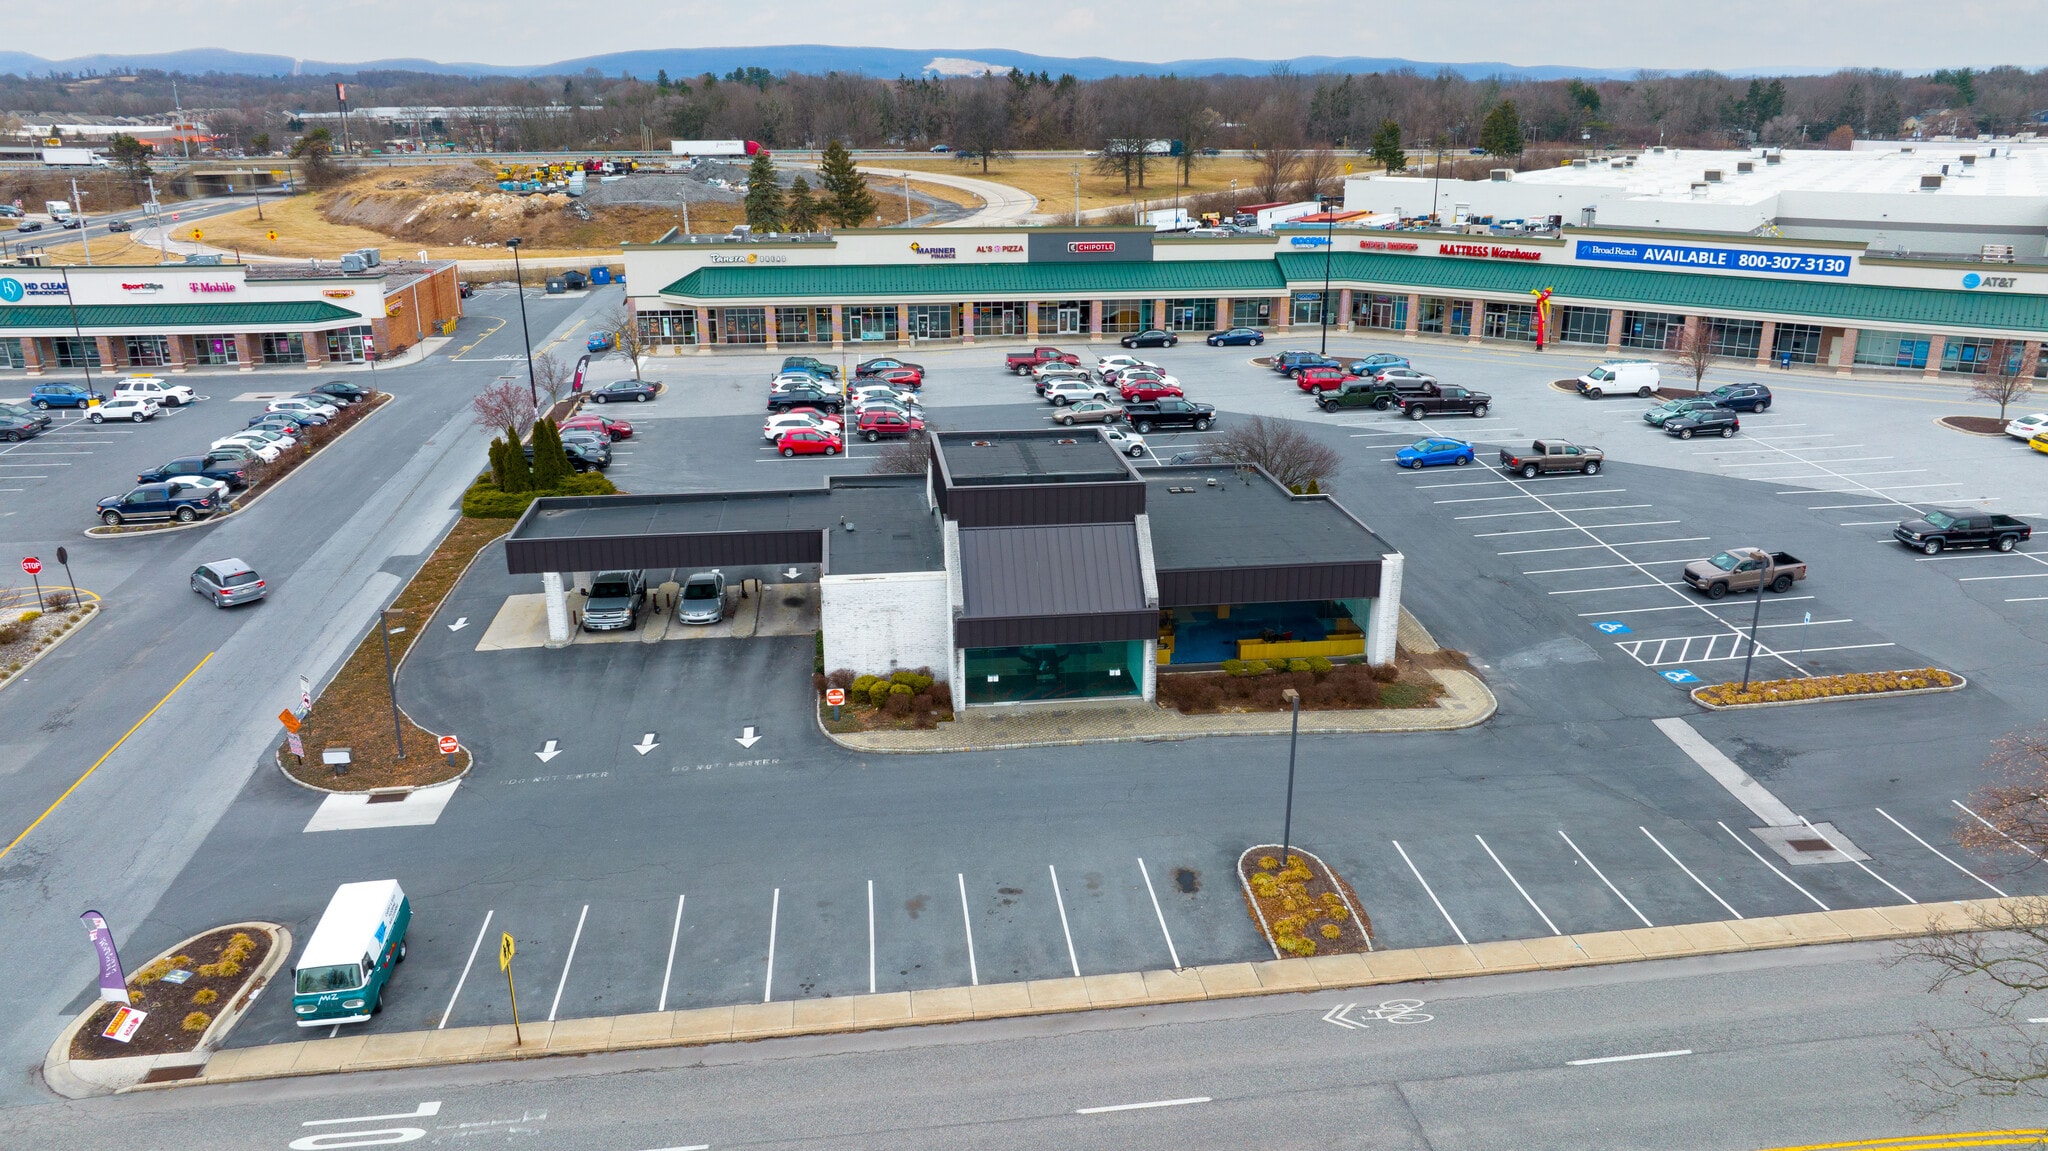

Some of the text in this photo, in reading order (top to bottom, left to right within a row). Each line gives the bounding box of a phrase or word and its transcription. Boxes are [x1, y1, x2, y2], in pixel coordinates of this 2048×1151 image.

[976, 245, 993, 253] AL'S
[1439, 244, 1541, 260] MATTRESS Warehouse
[1592, 245, 1615, 254] Broad
[1615, 247, 1638, 256] Reach
[1643, 248, 1845, 273] AVAILABLE 800-307-3130
[24, 282, 38, 290] HD
[1981, 276, 2017, 288] AT&T
[23, 562, 41, 570] STOP
